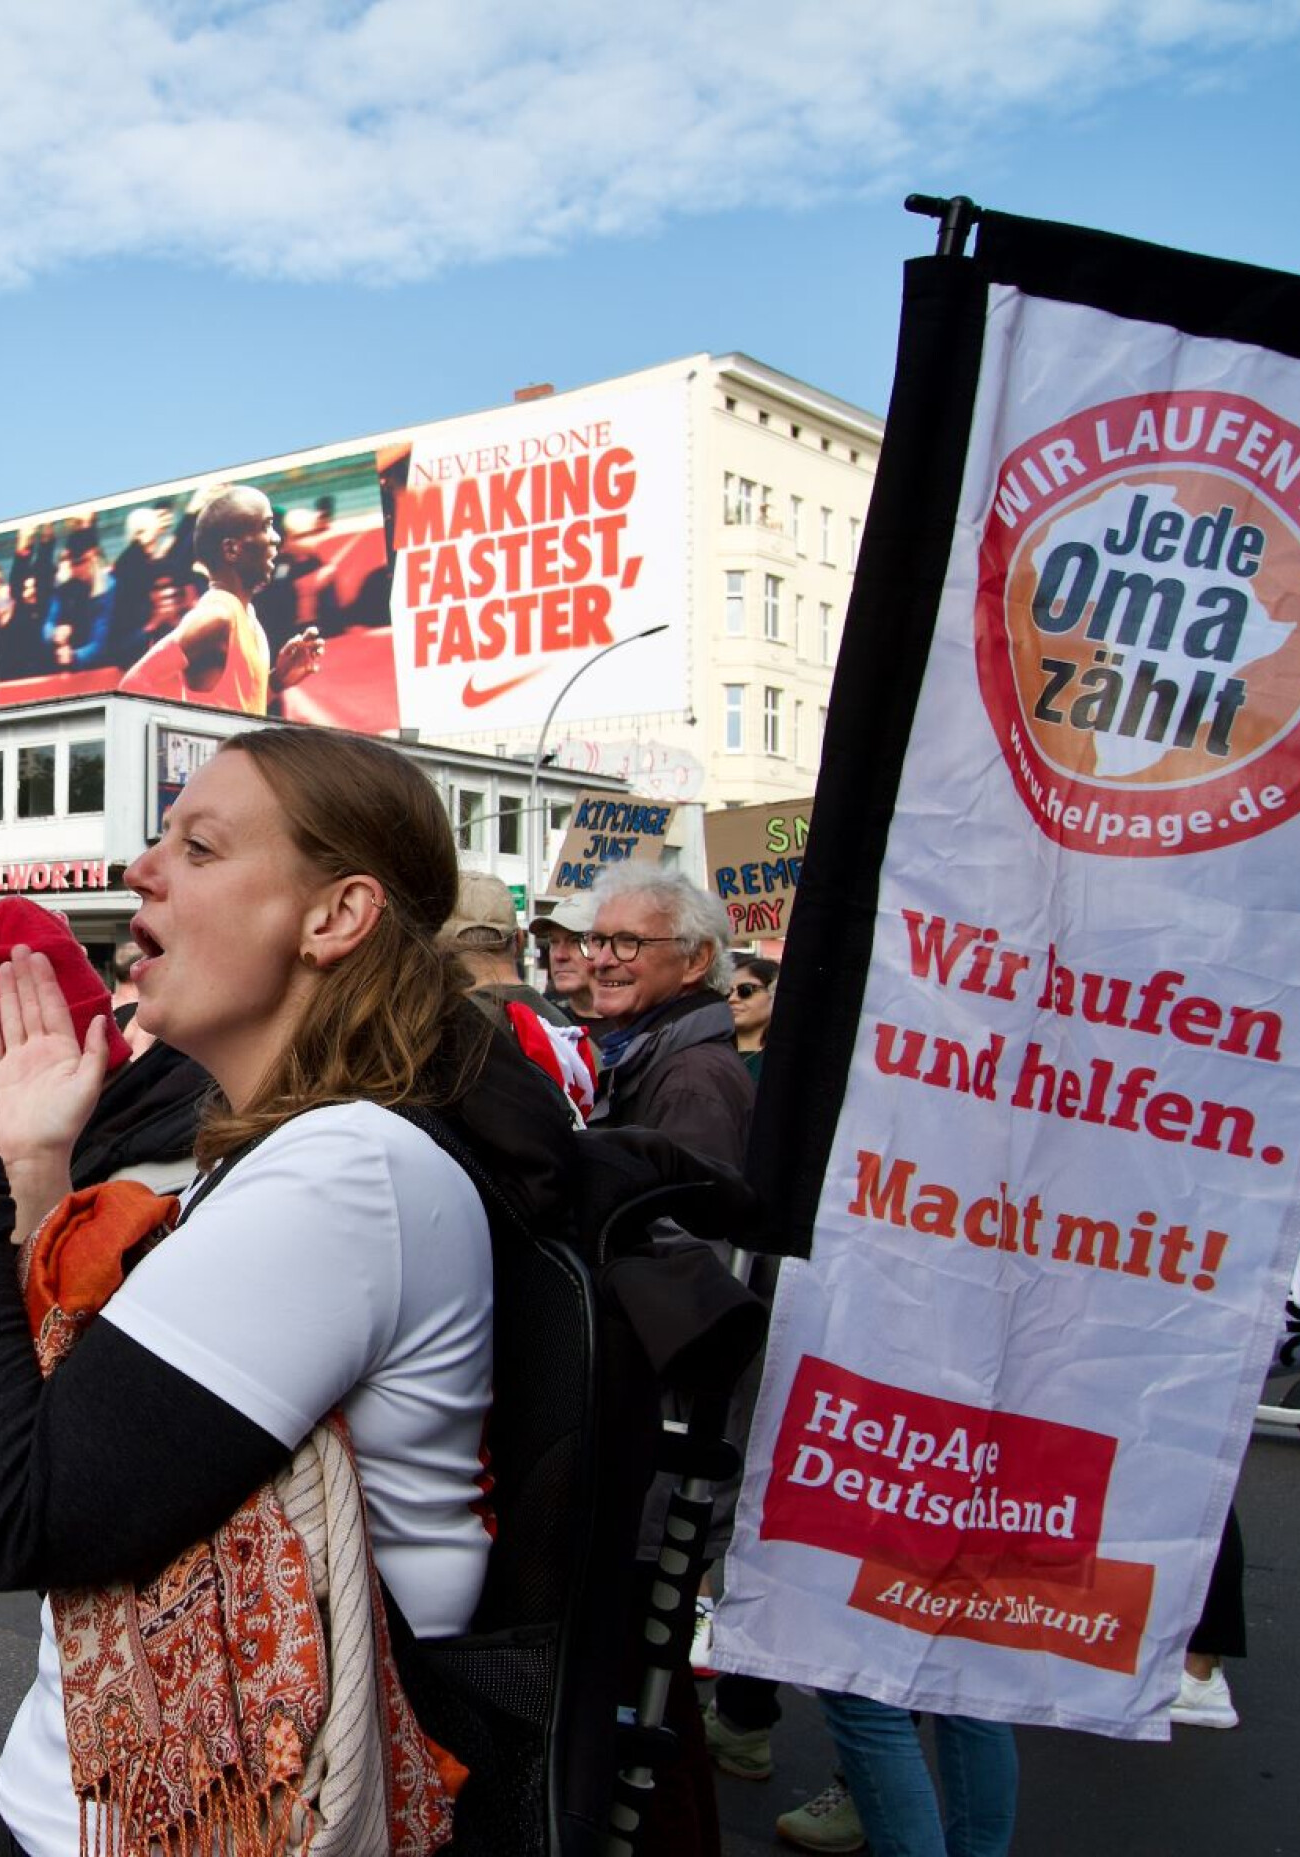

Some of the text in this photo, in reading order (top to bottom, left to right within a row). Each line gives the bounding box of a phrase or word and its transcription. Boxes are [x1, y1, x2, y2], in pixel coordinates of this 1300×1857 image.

[393, 446, 637, 551] MAKING
[414, 420, 612, 487] NEVER DONE
[994, 406, 1300, 529] WIR LAUFEN
[406, 513, 644, 609] FASTEST,
[1103, 494, 1266, 579] Jede
[414, 584, 615, 668] FASTER
[1030, 541, 1250, 664] Oma
[1033, 650, 1247, 758] zählt
[575, 797, 671, 836] KIPCHOGE
[1010, 720, 1287, 847] www.helpage.de
[583, 836, 640, 862] JUST
[727, 898, 785, 935] PAY
[901, 908, 1284, 1063] Wir laufen
[874, 1022, 1286, 1165] und helfen.
[848, 1150, 1229, 1292] Macht mit!
[804, 1390, 999, 1484] HelpAge
[787, 1444, 1077, 1540] Deutschland
[876, 1580, 1121, 1645] Alter ist Zukunft
